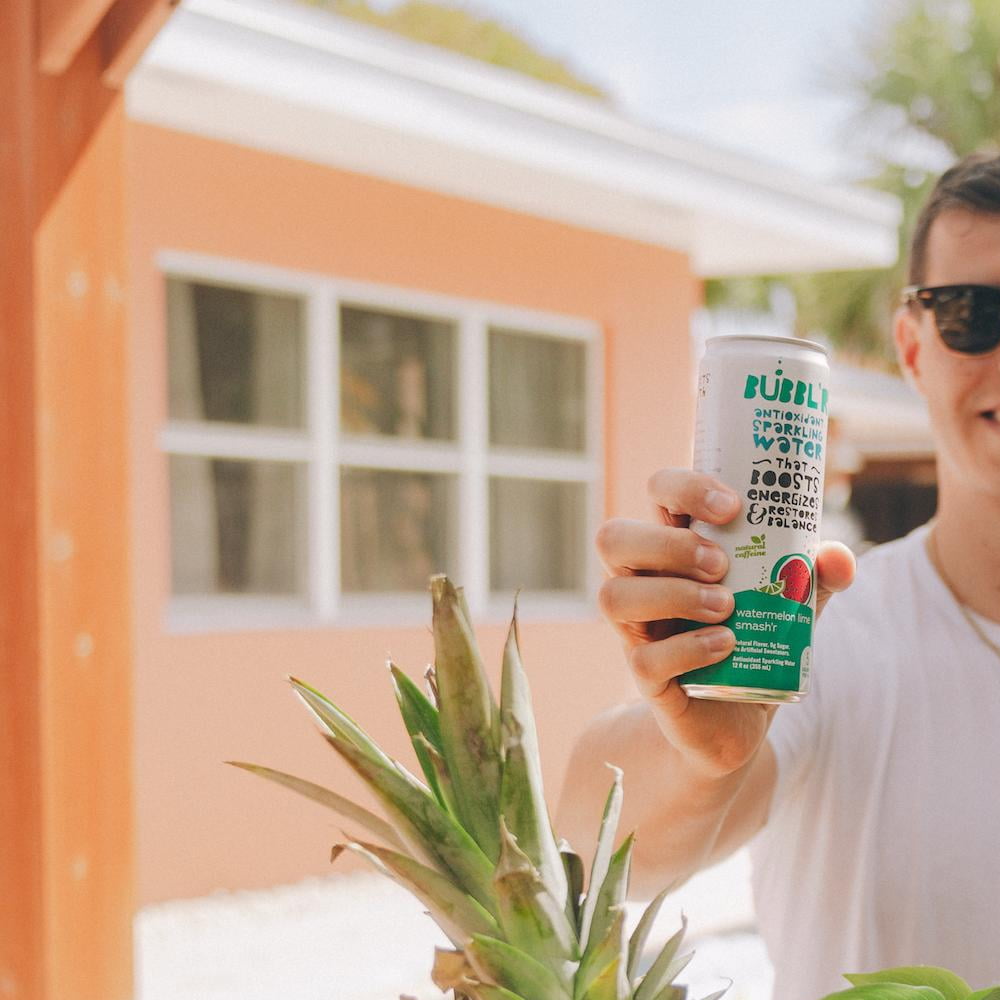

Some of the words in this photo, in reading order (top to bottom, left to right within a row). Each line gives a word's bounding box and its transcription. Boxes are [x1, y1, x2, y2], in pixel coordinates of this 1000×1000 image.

[750, 469, 819, 493] BOOSTS
[746, 503, 767, 525] &
[736, 608, 796, 622] watermelon
[735, 622, 777, 632] smash'r
